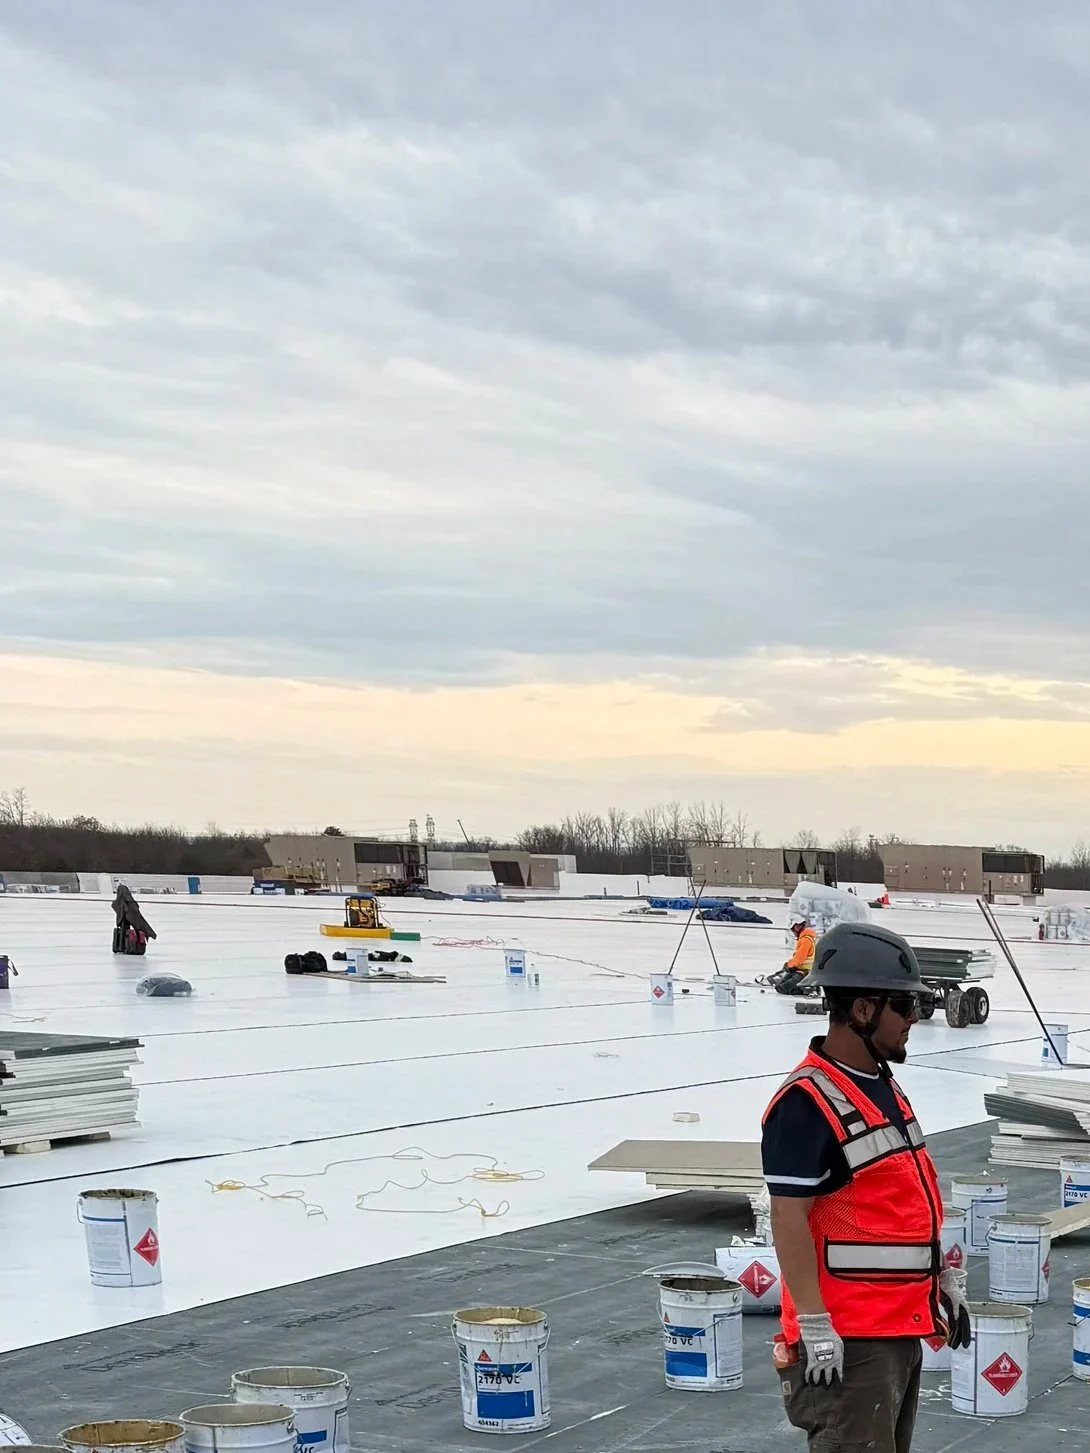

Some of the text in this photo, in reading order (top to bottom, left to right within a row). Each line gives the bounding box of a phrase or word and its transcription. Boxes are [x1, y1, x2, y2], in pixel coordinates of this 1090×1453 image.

[680, 1337, 694, 1346] VC
[478, 1375, 521, 1385] 2170 VC
